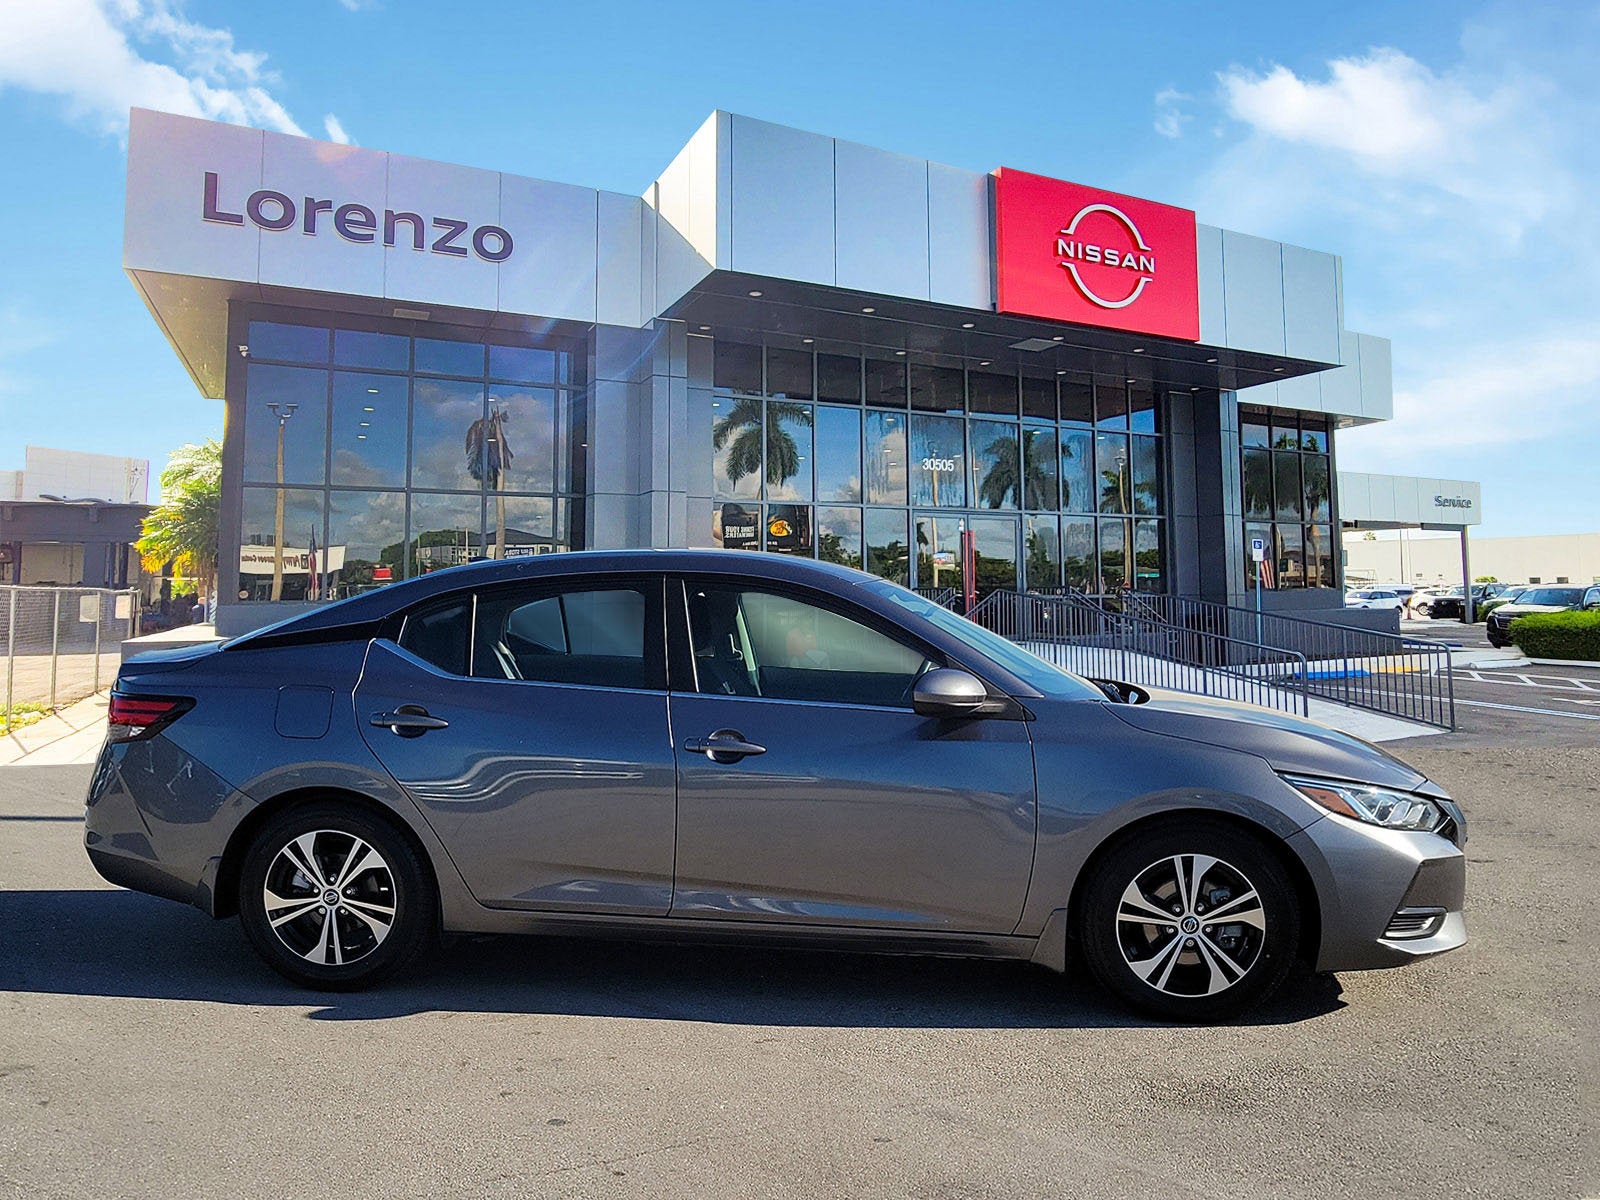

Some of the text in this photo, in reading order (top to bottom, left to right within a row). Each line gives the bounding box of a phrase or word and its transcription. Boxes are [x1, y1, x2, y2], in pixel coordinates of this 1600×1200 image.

[202, 171, 514, 262] Lorenzo
[1057, 238, 1155, 273] NISSAN
[922, 457, 955, 472] 30505
[1434, 495, 1472, 509] Service
